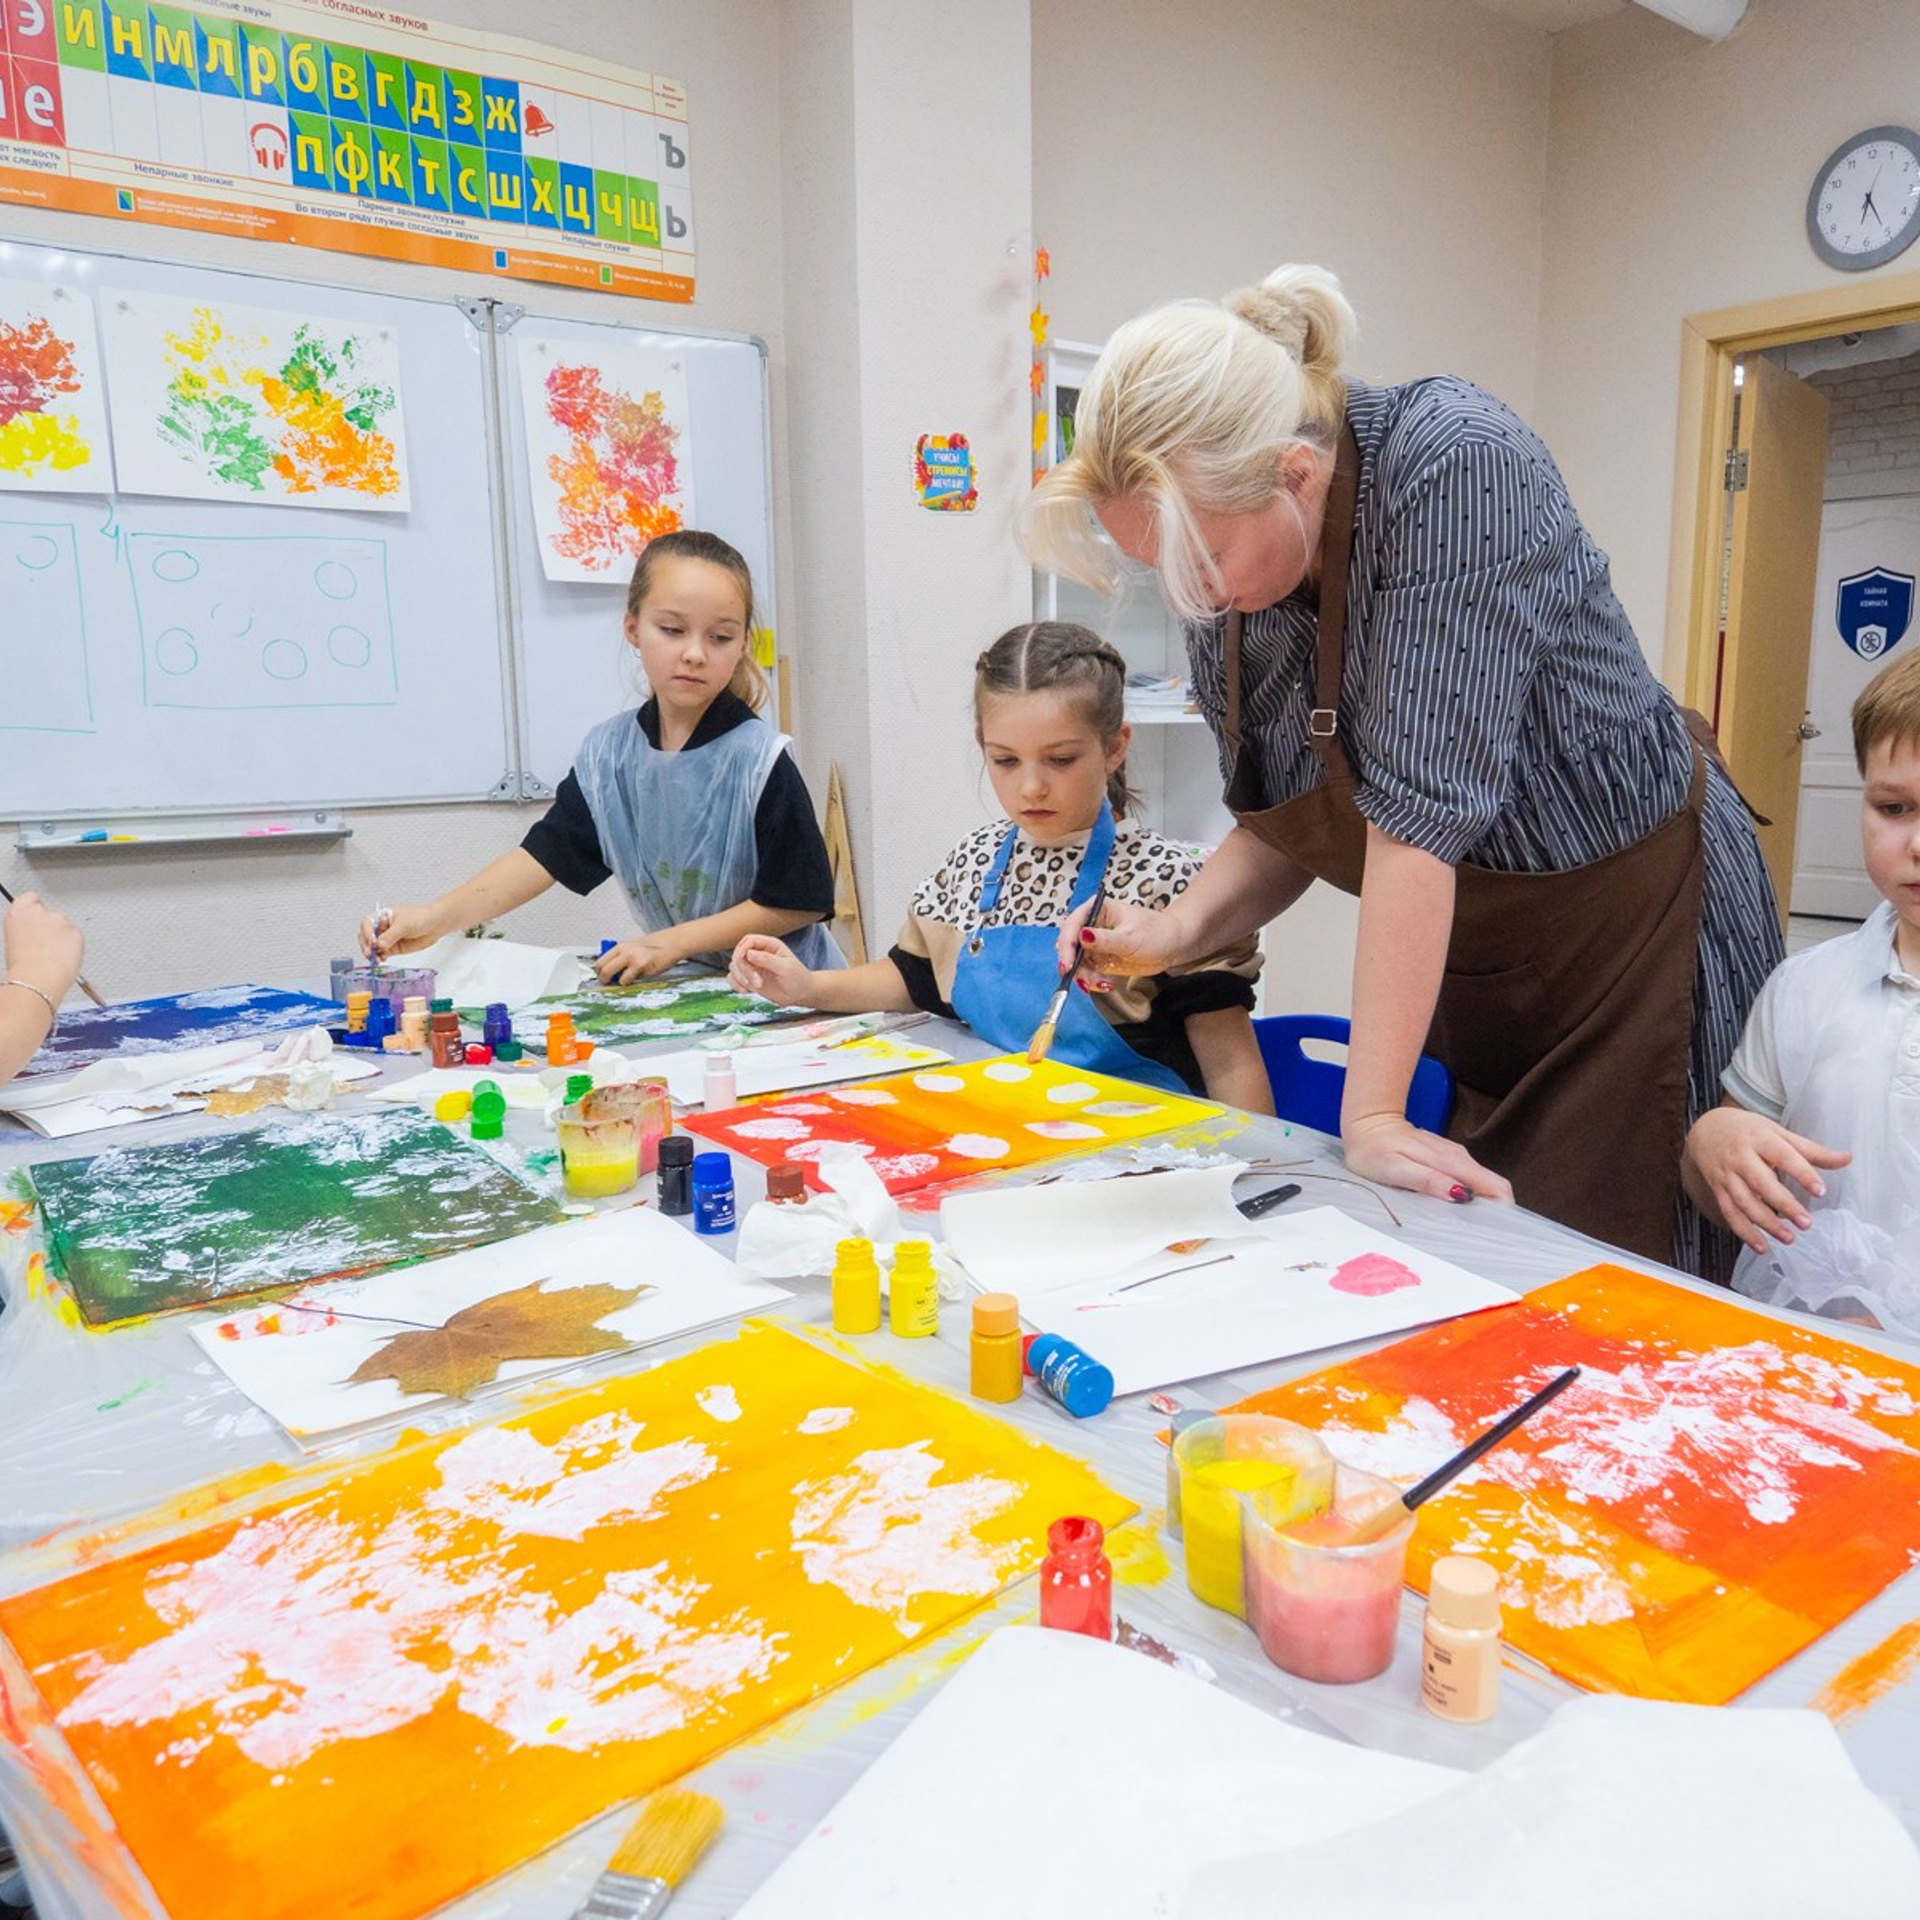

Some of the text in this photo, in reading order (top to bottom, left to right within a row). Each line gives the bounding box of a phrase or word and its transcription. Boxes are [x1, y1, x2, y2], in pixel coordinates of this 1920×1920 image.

[323, 0, 429, 32] согласных звуков
[63, 4, 97, 49] и
[111, 14, 144, 60] н
[154, 24, 195, 69] м
[205, 35, 236, 77] л
[247, 44, 278, 96] р
[288, 42, 320, 93] б
[331, 62, 361, 100] в
[374, 71, 395, 108] г
[410, 80, 442, 130] д
[452, 89, 475, 126] з
[485, 94, 518, 134] ж
[13, 147, 61, 160] мягкость
[1867, 149, 1878, 160] 12
[1889, 150, 1895, 159] 1
[13, 157, 58, 170] следуют
[24, 84, 55, 128] е
[296, 134, 325, 174] п
[334, 130, 370, 195] ф
[377, 150, 404, 190] к
[417, 158, 440, 195] т
[458, 167, 478, 203] с
[488, 171, 523, 210] ш
[531, 177, 554, 215] х
[564, 184, 591, 230] ц
[601, 191, 622, 227] ч
[629, 197, 660, 242] щ
[1848, 159, 1856, 169] 11
[1902, 162, 1909, 172] 2
[134, 163, 234, 187] Непарные звонкие
[1832, 179, 1842, 189] 10
[358, 199, 466, 226] Парные звонкие/глухие
[1825, 203, 1832, 213] 9
[1901, 206, 1908, 215] 4
[295, 203, 480, 242] Во втором ряду глухие согласные звуки
[1830, 223, 1837, 233] 8
[562, 233, 631, 253] Непарные глухие
[1844, 235, 1850, 245] 7
[1863, 237, 1870, 248] 6
